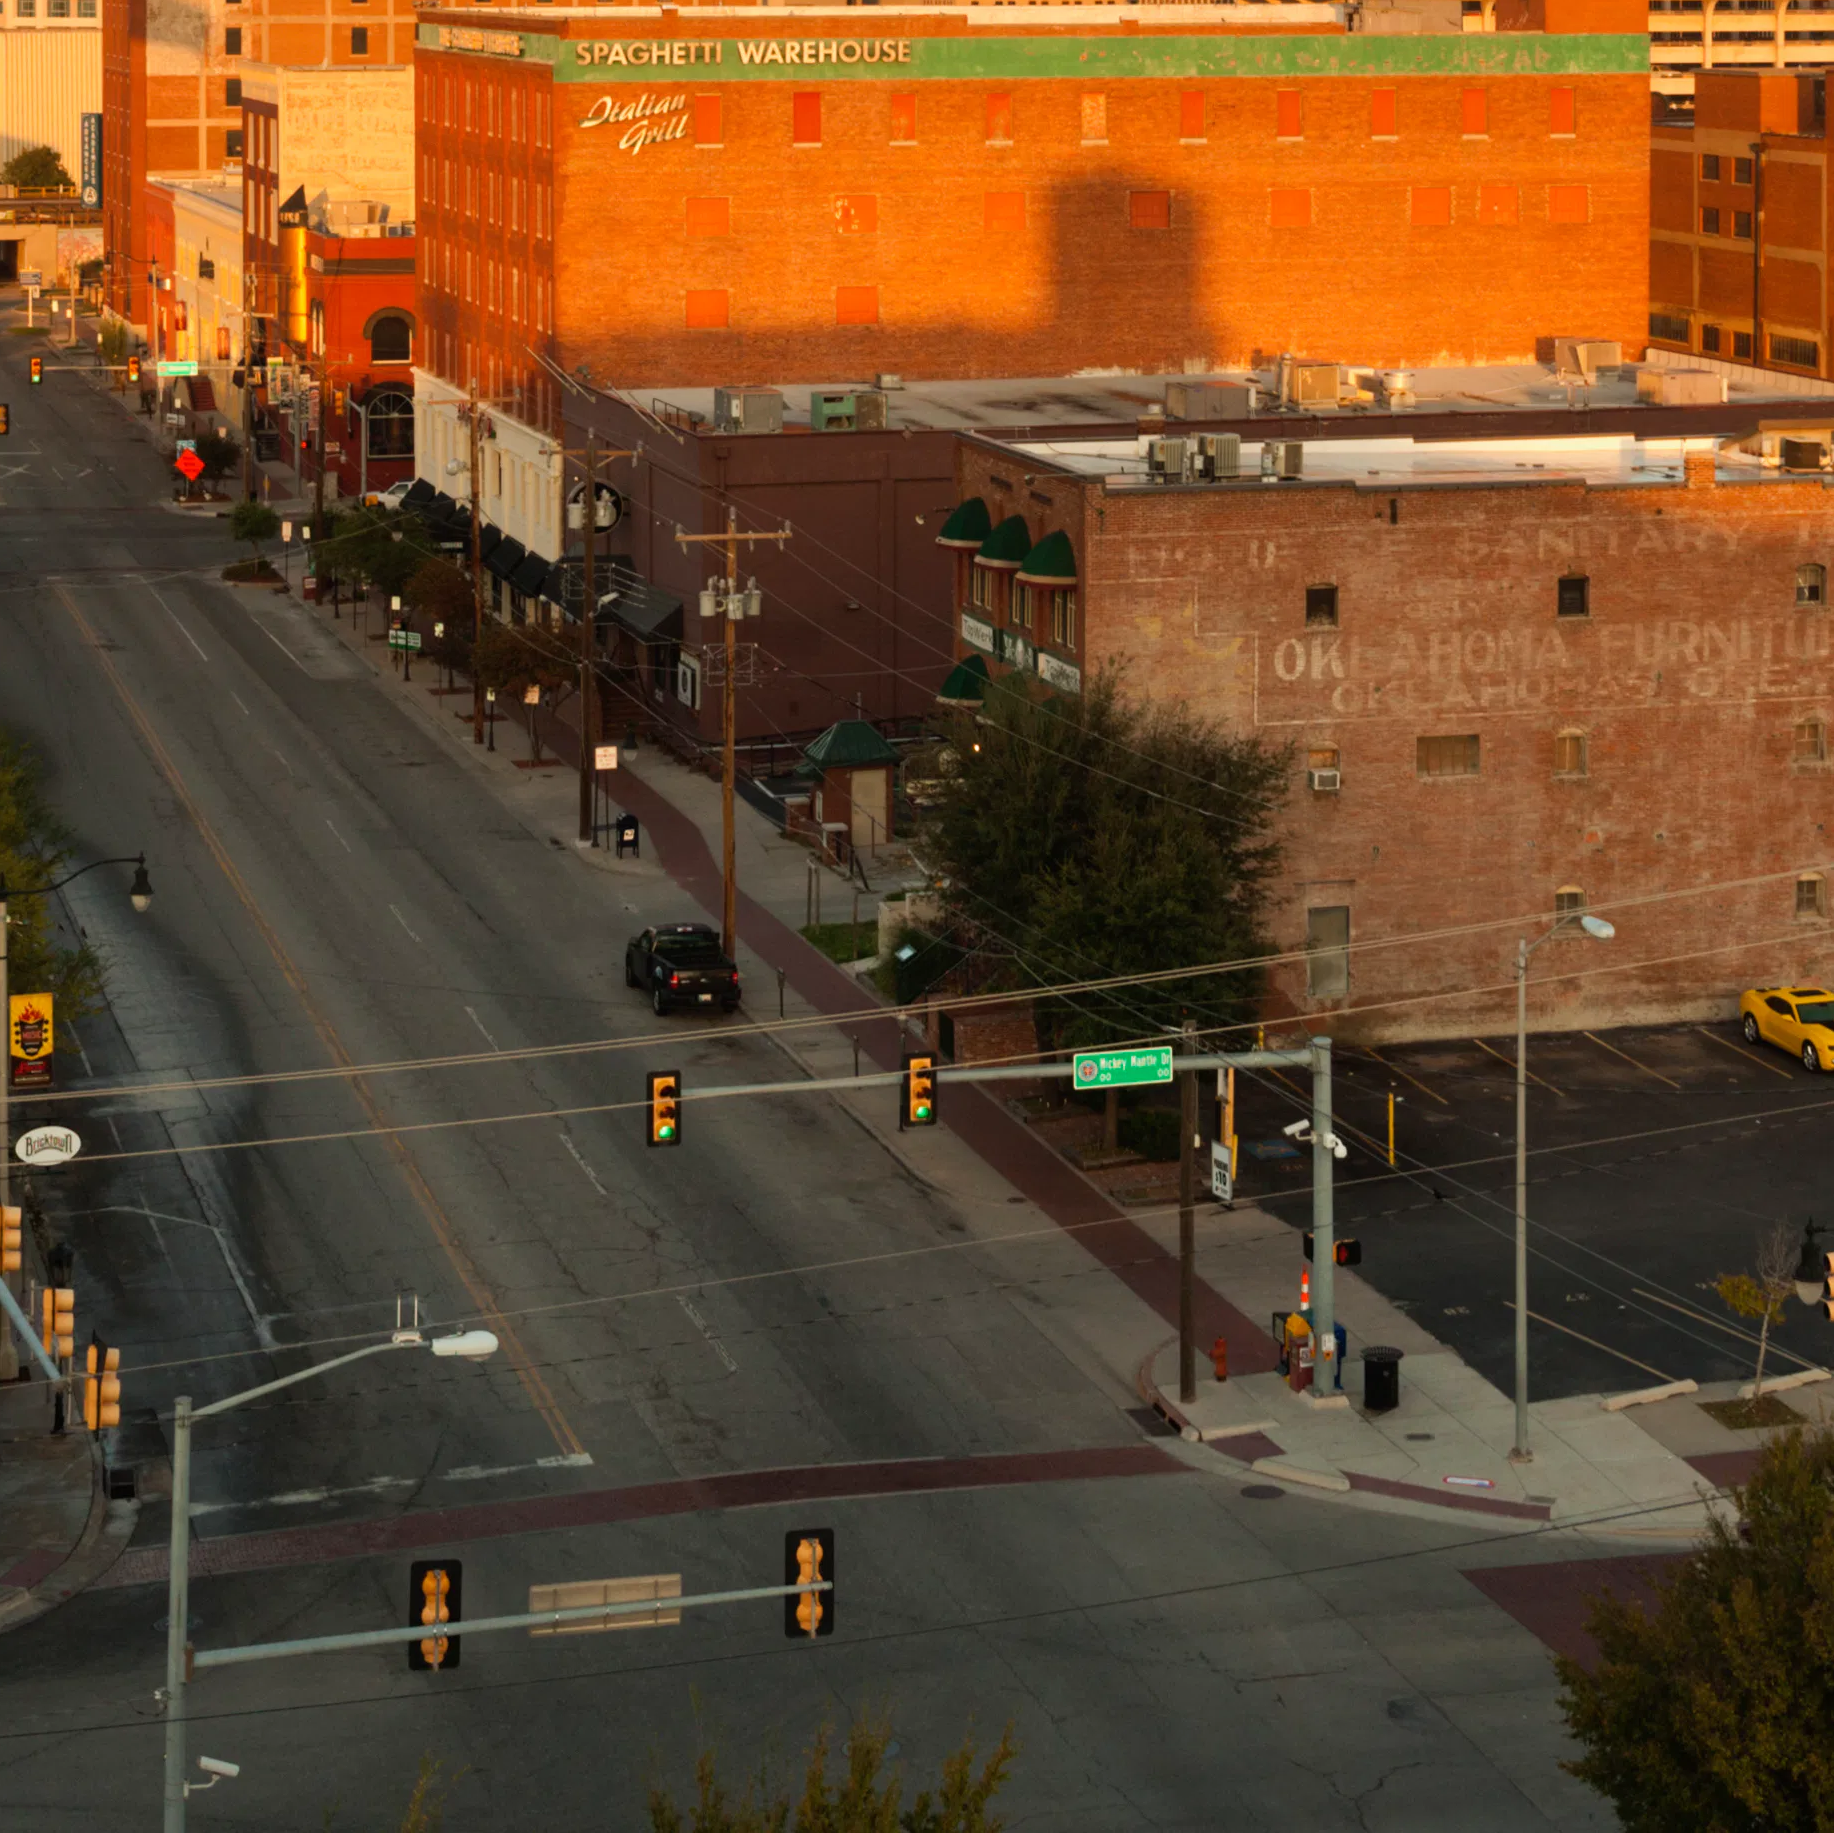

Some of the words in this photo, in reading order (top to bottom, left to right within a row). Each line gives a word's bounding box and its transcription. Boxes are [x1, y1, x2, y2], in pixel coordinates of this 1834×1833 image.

[575, 42, 723, 66] SPAGHETTI
[738, 40, 912, 66] WAREHOUSE
[580, 92, 687, 128] Italian
[618, 113, 690, 156] Grill
[1273, 627, 1573, 681] OKLAHOMA
[1099, 1055, 1128, 1071] Mickey
[1130, 1053, 1157, 1067] Mantle
[1160, 1052, 1171, 1065] Dr
